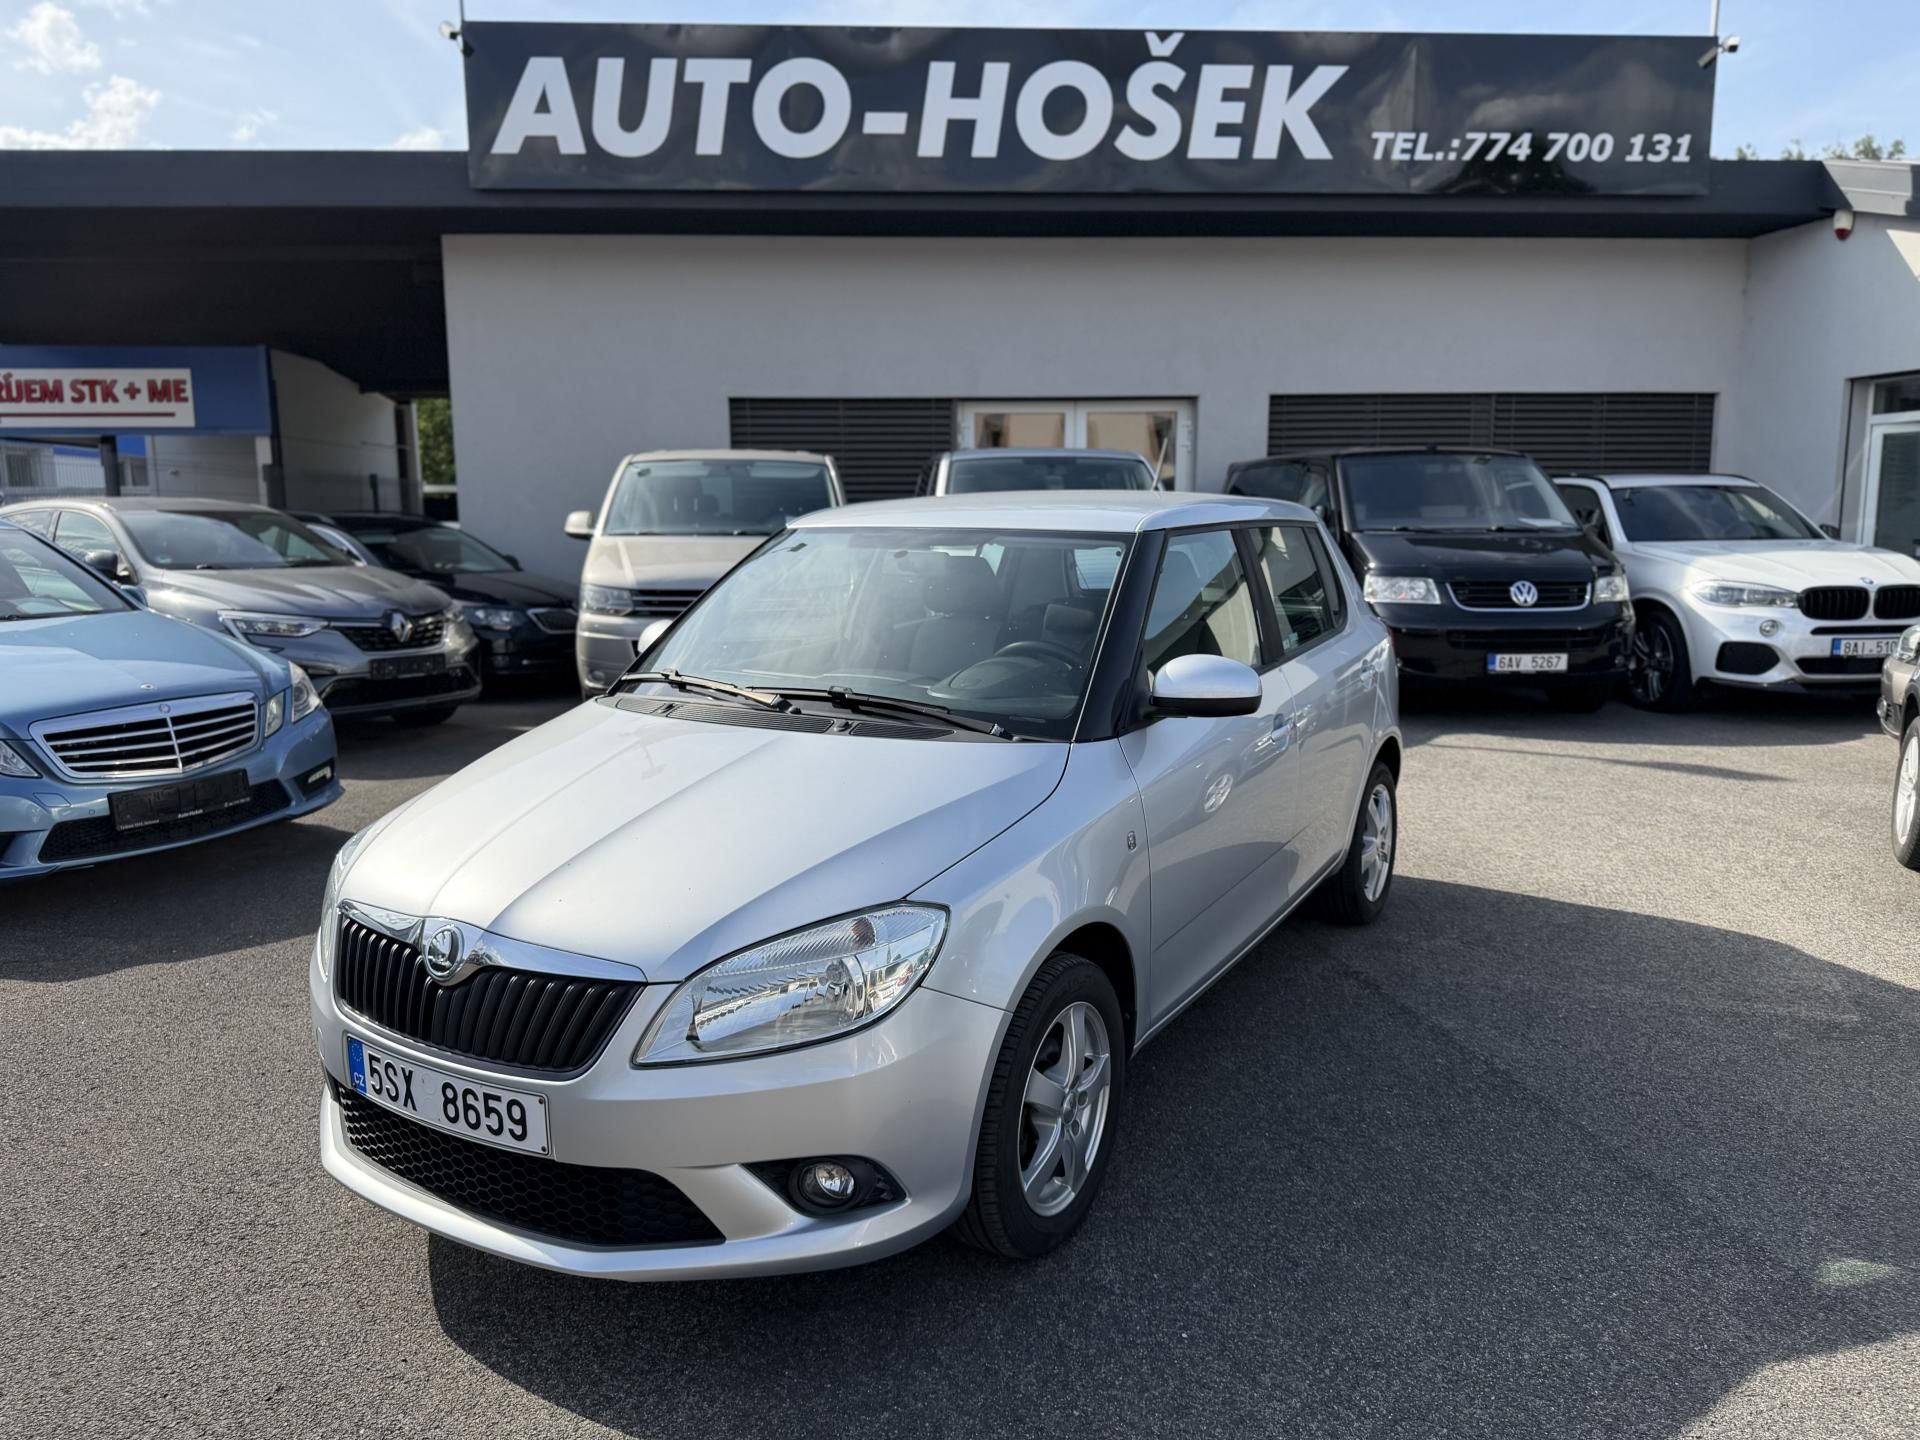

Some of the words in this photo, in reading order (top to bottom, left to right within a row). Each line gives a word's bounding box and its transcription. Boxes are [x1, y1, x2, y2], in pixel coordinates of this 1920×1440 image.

[490, 32, 1349, 160] AUTO-HOŠEK
[1371, 131, 1533, 162] TEL.:774
[1543, 132, 1614, 163] 700
[1624, 133, 1692, 163] 131
[69, 379, 119, 403] STK
[123, 382, 141, 400] +
[147, 379, 189, 403] ME
[1498, 656, 1522, 669] 6AV
[1531, 655, 1562, 669] 5267
[353, 1071, 366, 1088] CZ
[368, 1051, 417, 1112] 5SX
[441, 1082, 528, 1142] 8659
